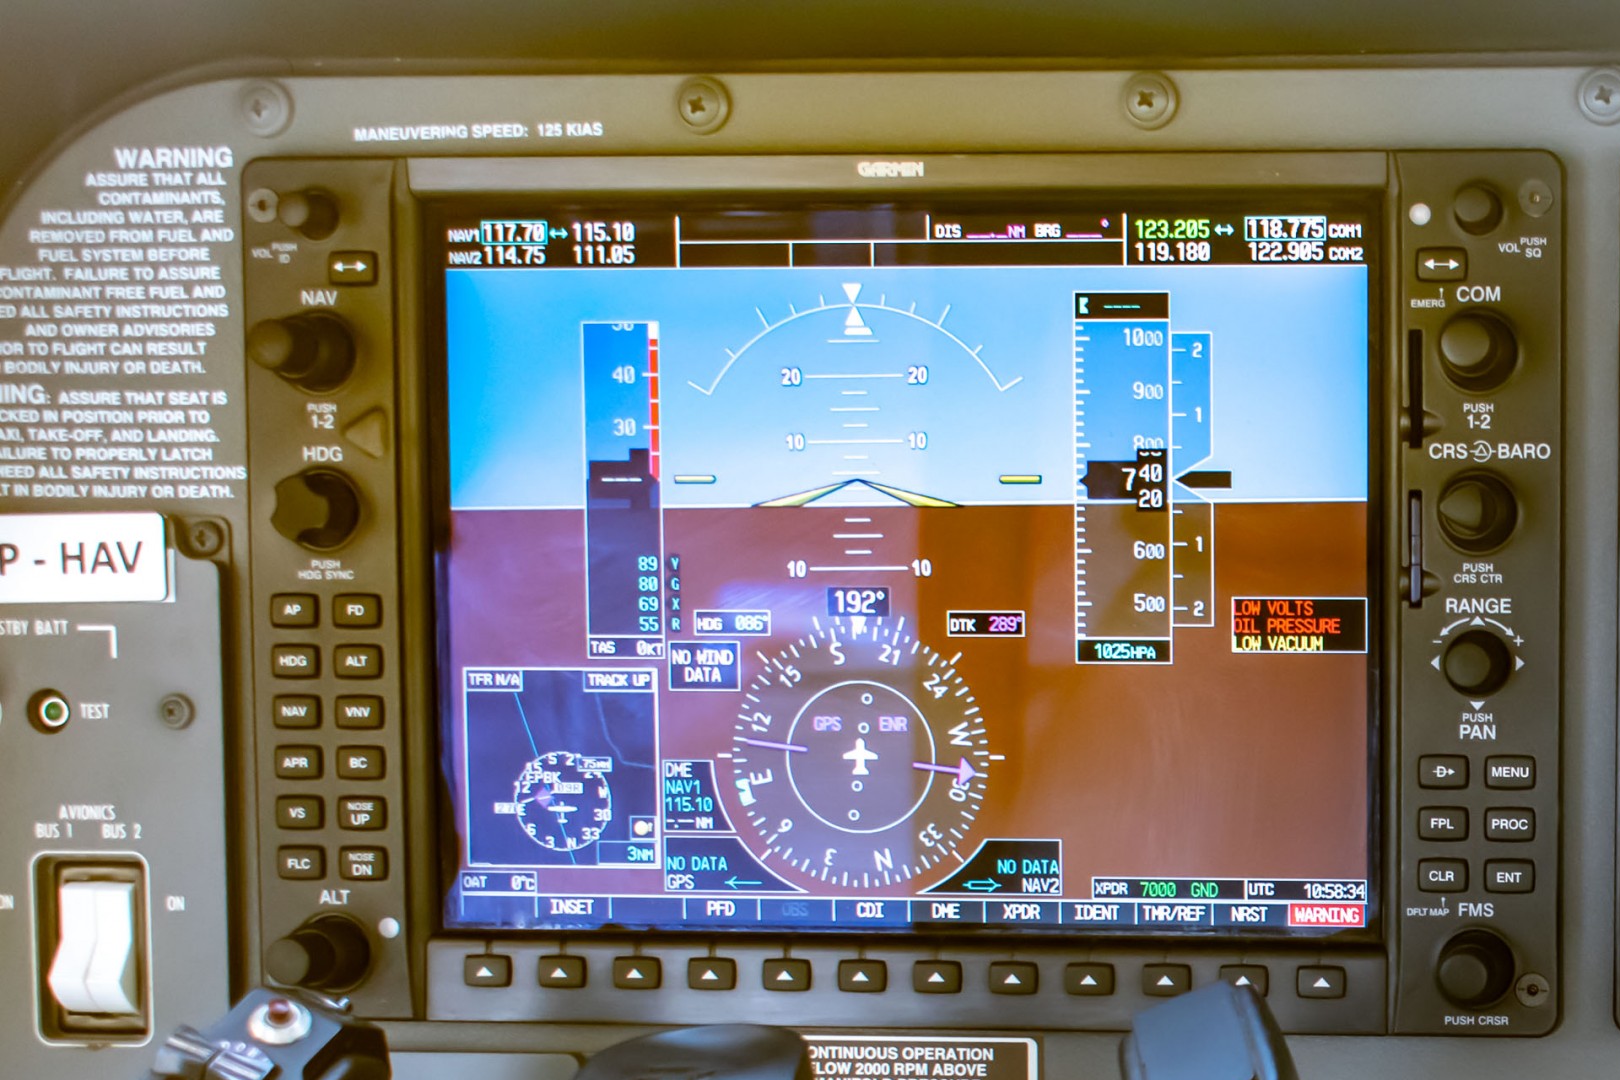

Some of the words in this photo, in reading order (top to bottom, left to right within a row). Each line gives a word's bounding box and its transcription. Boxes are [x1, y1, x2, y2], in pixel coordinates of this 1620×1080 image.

[354, 125, 467, 142] MANEUVERING
[472, 124, 528, 140] SPEED:
[538, 123, 562, 138] 125
[567, 122, 603, 137] KIAS
[114, 148, 233, 169] WARNING
[86, 173, 148, 186] ASSURE
[152, 173, 194, 186] THAT
[198, 172, 226, 185] ALL
[41, 211, 124, 224] INCLUDING
[193, 210, 223, 223] ARE
[448, 229, 480, 242] NAV1
[484, 224, 545, 241] 117.70
[572, 223, 635, 242] 115.10
[1135, 220, 1210, 239] 123.205
[1248, 219, 1324, 239] 118.775
[1329, 224, 1362, 238] COM1
[449, 251, 482, 264] NAV2
[485, 246, 546, 264] 114.75
[573, 246, 635, 264] 111.05
[1135, 243, 1210, 262] 119.180
[1250, 242, 1324, 262] 122.905
[1329, 247, 1363, 261] COM2
[302, 291, 338, 306] NAV
[1457, 286, 1501, 301] COM
[1123, 328, 1163, 347] 1000
[612, 366, 635, 384] 40
[303, 447, 343, 462] HDG
[1429, 443, 1468, 459] CRS
[1498, 443, 1551, 459] BARO
[61, 541, 143, 574] HAV
[284, 605, 301, 616] AP
[347, 605, 364, 615] FD
[1234, 601, 1262, 616] LOW
[1267, 601, 1313, 616] VOLTS
[1446, 598, 1511, 614] RANGE
[951, 618, 975, 632] DTK
[1234, 618, 1262, 633] OIL
[1267, 618, 1341, 634] PRESSURE
[1095, 643, 1156, 659] 1025HPA
[1234, 636, 1262, 651] LOW
[1268, 636, 1323, 651] VACUUM
[672, 650, 691, 665] NO
[696, 649, 734, 665] WIND
[685, 667, 721, 682] DATA
[80, 705, 109, 719] TEST
[1492, 765, 1529, 778] MENU
[59, 805, 116, 820] AVIONICS
[36, 824, 61, 839] BUS
[67, 825, 73, 838] 1
[103, 824, 128, 839] BUS
[134, 825, 141, 839] 2
[1095, 882, 1128, 896] XPDR
[1141, 882, 1176, 897] 7000
[1191, 882, 1218, 898] GND
[1249, 883, 1274, 897] UTC
[1304, 883, 1365, 899] 10:58:34
[550, 900, 594, 914] INSET
[1074, 905, 1120, 920] IDENT
[1143, 906, 1205, 921] TMR/REF
[1458, 903, 1494, 917] FMS
[1295, 908, 1359, 923] WARNING
[1444, 1015, 1475, 1026] PUSH
[1478, 1015, 1509, 1025] CRSR
[902, 1047, 994, 1061] OPERATION
[855, 1062, 889, 1076] 2000
[894, 1063, 928, 1077] RPM
[933, 1063, 987, 1078] ABOVE
